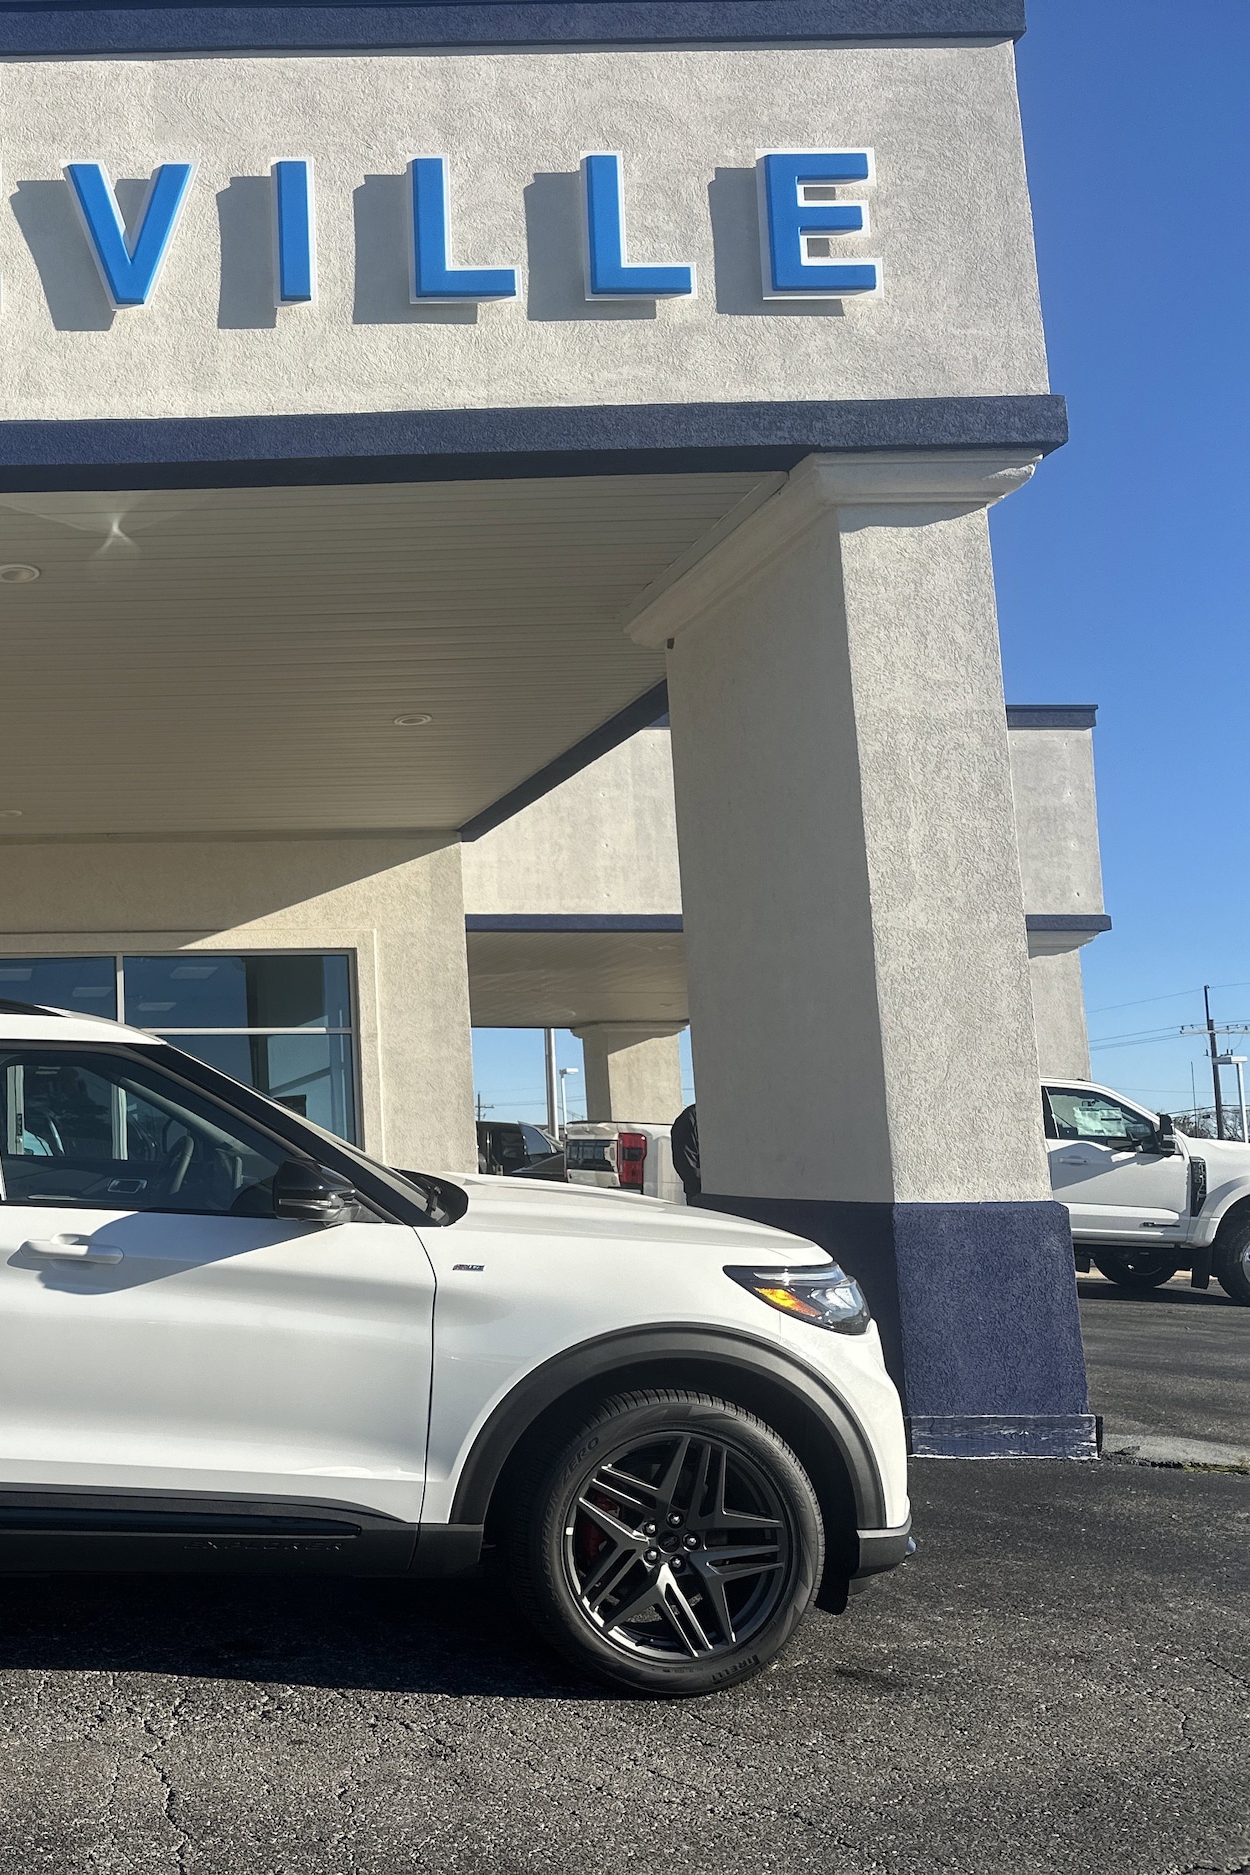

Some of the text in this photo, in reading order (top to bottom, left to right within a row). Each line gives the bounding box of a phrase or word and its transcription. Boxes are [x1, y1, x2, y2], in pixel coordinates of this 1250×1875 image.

[541, 1489, 560, 1603] SCORPION
[559, 1436, 599, 1487] ZERO
[710, 1654, 761, 1686] PIRELLI
